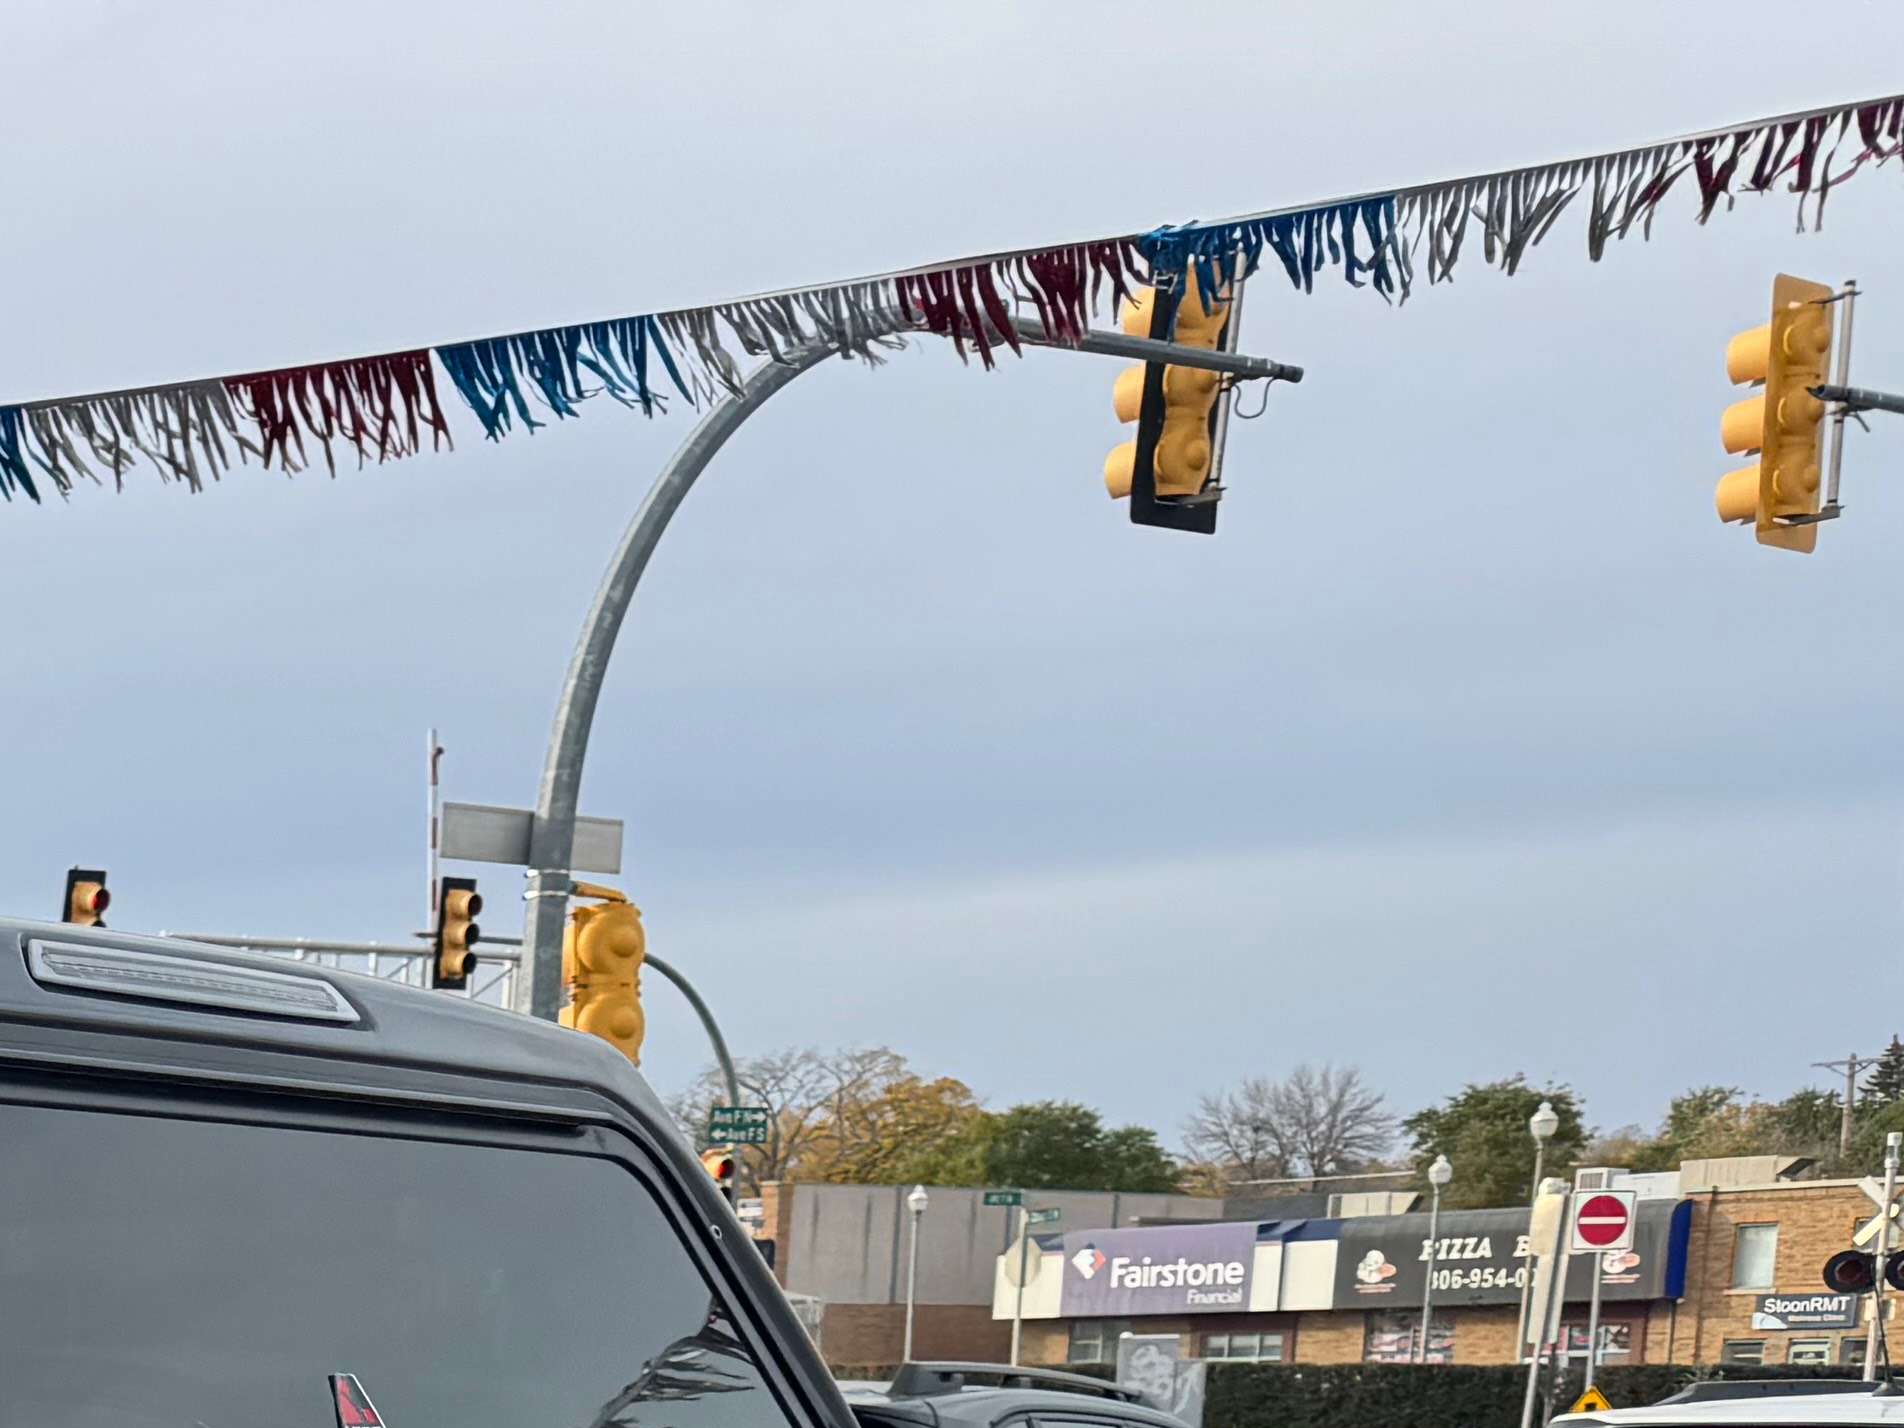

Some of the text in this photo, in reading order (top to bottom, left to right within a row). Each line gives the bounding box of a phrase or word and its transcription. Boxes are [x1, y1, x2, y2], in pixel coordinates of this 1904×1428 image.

[1418, 1237, 1493, 1261] PIZZA
[1110, 1256, 1244, 1289] Fairstone
[1187, 1288, 1243, 1305] Financial
[1763, 1296, 1851, 1313] StoonRMT
